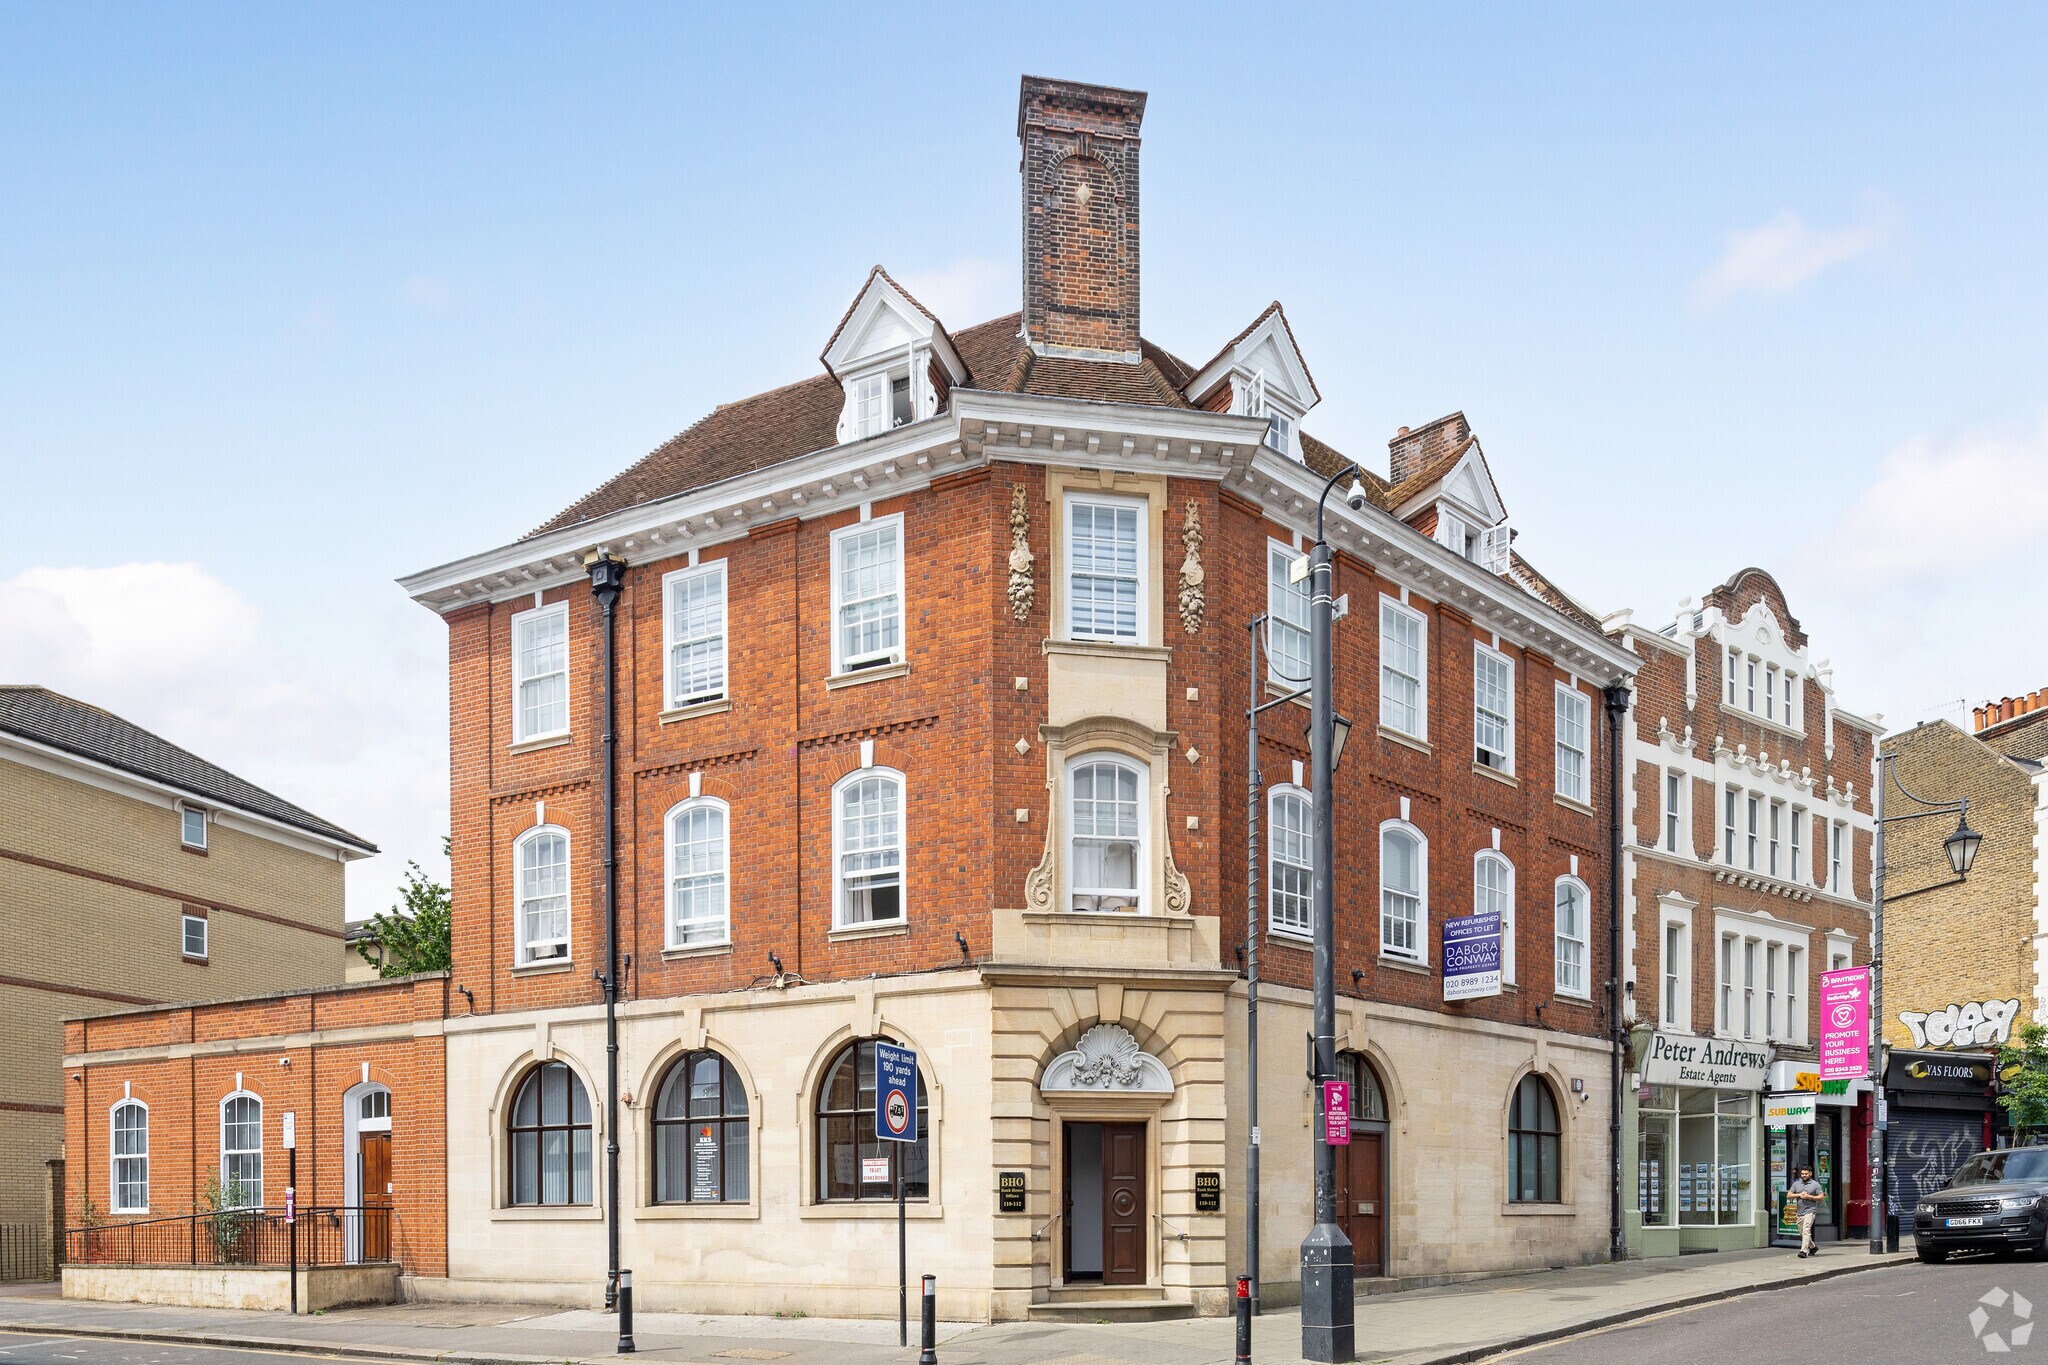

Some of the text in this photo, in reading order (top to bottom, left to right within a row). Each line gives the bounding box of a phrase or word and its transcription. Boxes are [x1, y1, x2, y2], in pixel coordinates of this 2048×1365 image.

[1446, 915, 1499, 929] NEW REFURBISHED
[1450, 928, 1472, 937] OFFICES
[1484, 924, 1494, 932] LET
[1446, 941, 1498, 958] DABORA
[1446, 951, 1498, 967] CONWAY
[1446, 975, 1498, 988] 020 8989 1234
[1446, 985, 1498, 996] daboraconway.com
[1825, 1030, 1859, 1039] PROMOTE
[1825, 1040, 1844, 1048] YOUR
[880, 1048, 914, 1065] Weight limit
[1652, 1036, 1766, 1069] Peter Andrews
[1825, 1047, 1860, 1056] BUSINESS
[1824, 1057, 1845, 1065] HERE!
[883, 1062, 911, 1076] 190 yards
[1679, 1066, 1736, 1085] Estate Agents
[1927, 1065, 1974, 1078] YAS FLOORS
[888, 1076, 906, 1087] ahead
[1794, 1072, 1851, 1095] SUBWAY
[1768, 1107, 1809, 1116] SUBWAY
[1001, 1178, 1024, 1187] BHO
[1197, 1177, 1218, 1186] BHO
